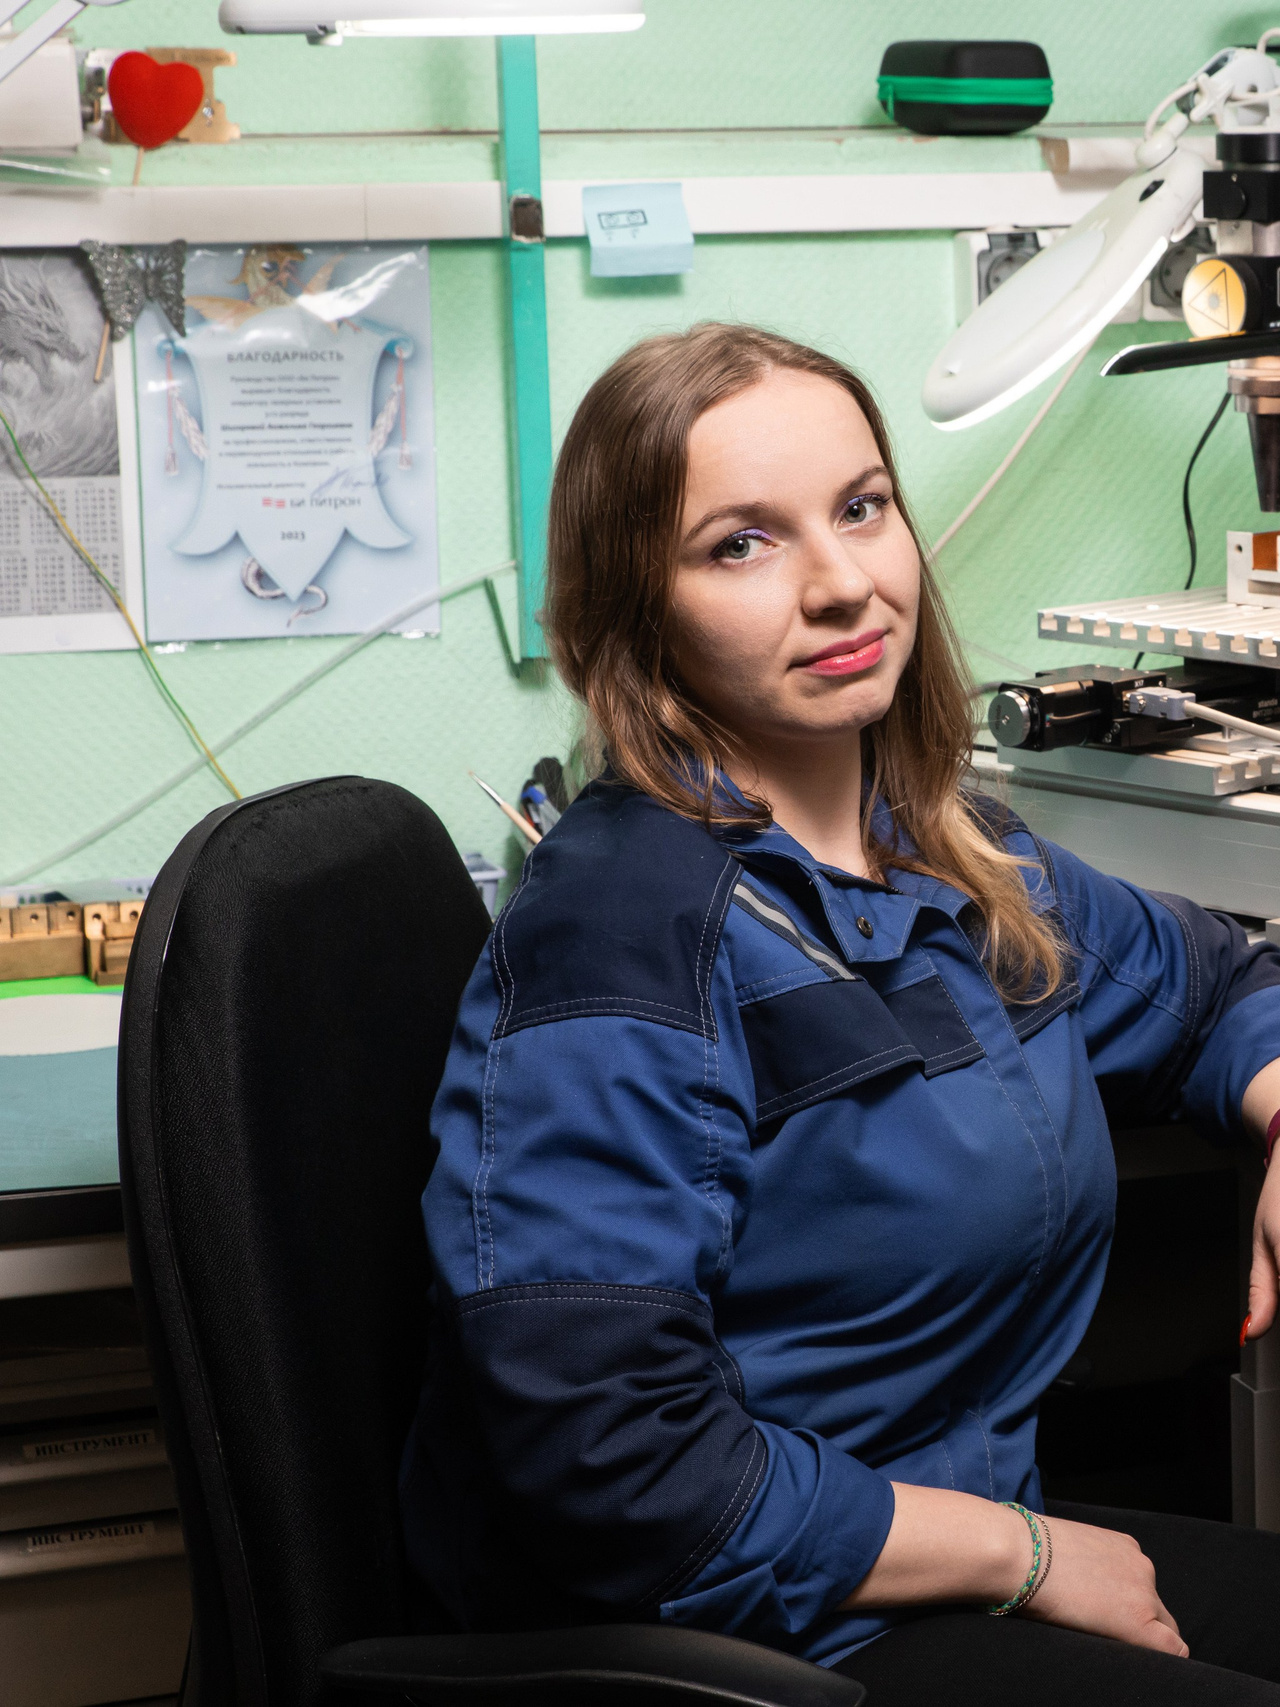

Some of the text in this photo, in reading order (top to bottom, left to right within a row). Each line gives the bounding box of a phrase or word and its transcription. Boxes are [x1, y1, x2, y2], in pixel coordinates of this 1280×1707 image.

[227, 350, 344, 364] БЛАГОДАРНОСТЬ
[34, 1432, 151, 1457] ИНСТРУМЕНТ
[31, 1523, 147, 1547] ИНСТРУМЕНТ
